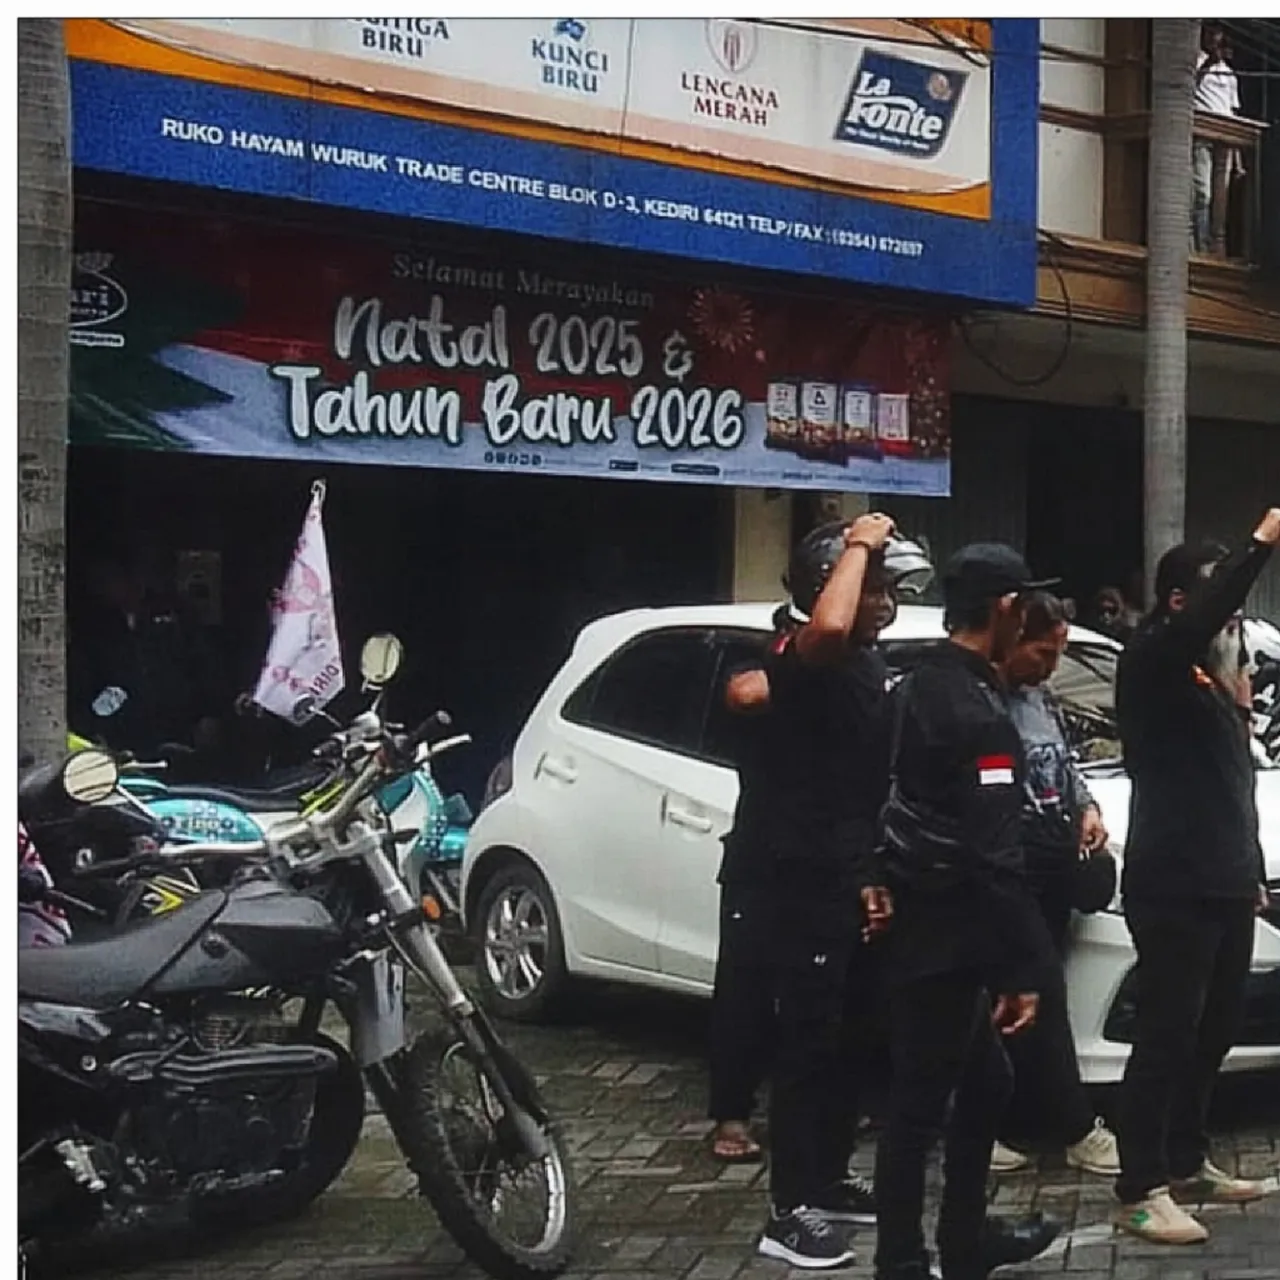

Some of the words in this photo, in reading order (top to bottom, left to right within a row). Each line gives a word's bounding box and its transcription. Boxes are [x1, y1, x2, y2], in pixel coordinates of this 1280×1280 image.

[362, 27, 423, 58] BIRU
[532, 38, 609, 72] KUNCI
[543, 65, 598, 93] BIRU
[681, 71, 779, 109] LENCANA
[856, 71, 890, 96] La
[694, 96, 767, 126] MERAH
[845, 95, 943, 140] Fonte
[162, 119, 223, 145] RUKO
[231, 130, 304, 158] HAYAM
[311, 143, 387, 172] WURUK
[395, 156, 463, 184] TRADE
[468, 169, 545, 198] CENTRE
[548, 183, 597, 207] BLOK
[644, 200, 699, 222] KEDIRI
[392, 252, 505, 290] Selamat
[517, 269, 655, 308] Merayakan
[334, 295, 509, 368] Natal
[528, 313, 643, 377] 2025
[664, 330, 694, 383] &
[272, 366, 460, 444] Tahun
[482, 374, 614, 444] Baru
[631, 385, 742, 446] 2026
